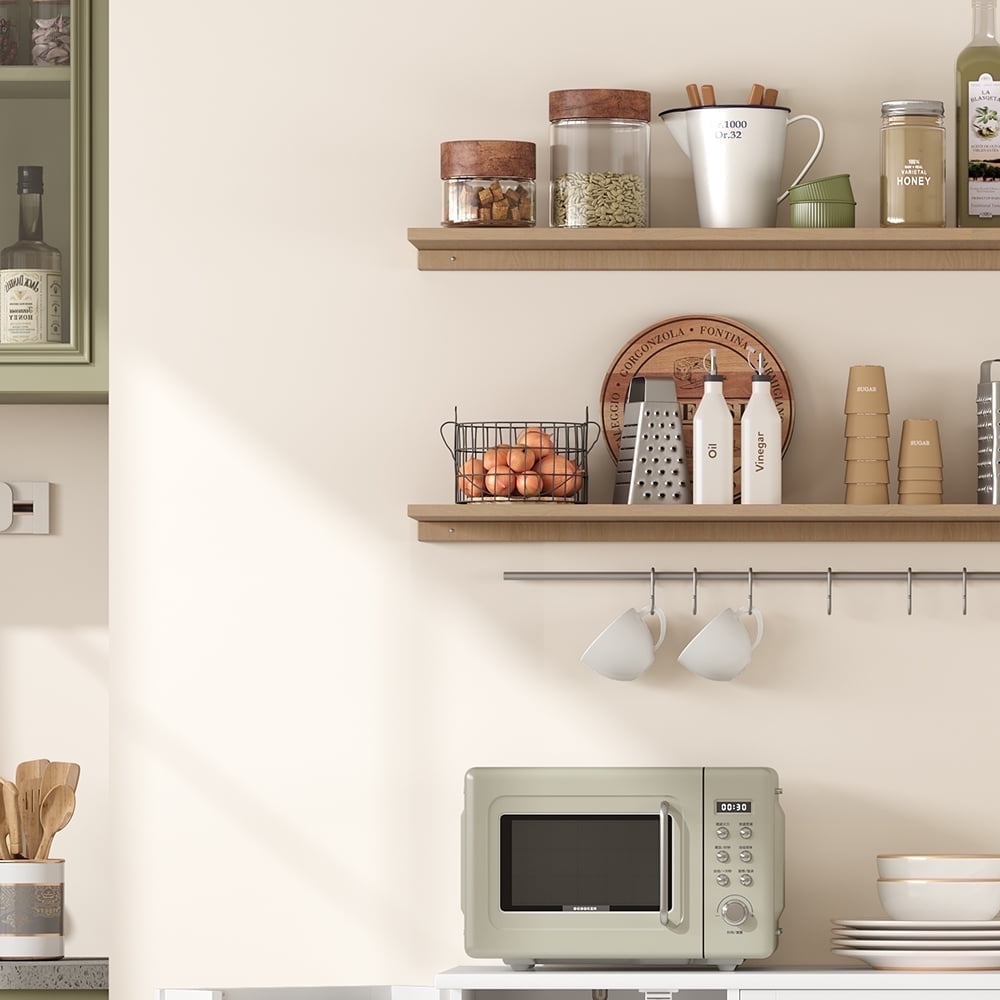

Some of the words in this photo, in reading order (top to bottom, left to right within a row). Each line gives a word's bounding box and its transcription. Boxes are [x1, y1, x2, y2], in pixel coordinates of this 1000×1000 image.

[897, 176, 931, 186] HONEY
[620, 328, 685, 378] GORGONZOLA
[700, 326, 751, 350] FONTINA
[708, 443, 718, 459] Oil
[755, 432, 767, 473] Vinegar
[721, 803, 747, 811] 00:30
